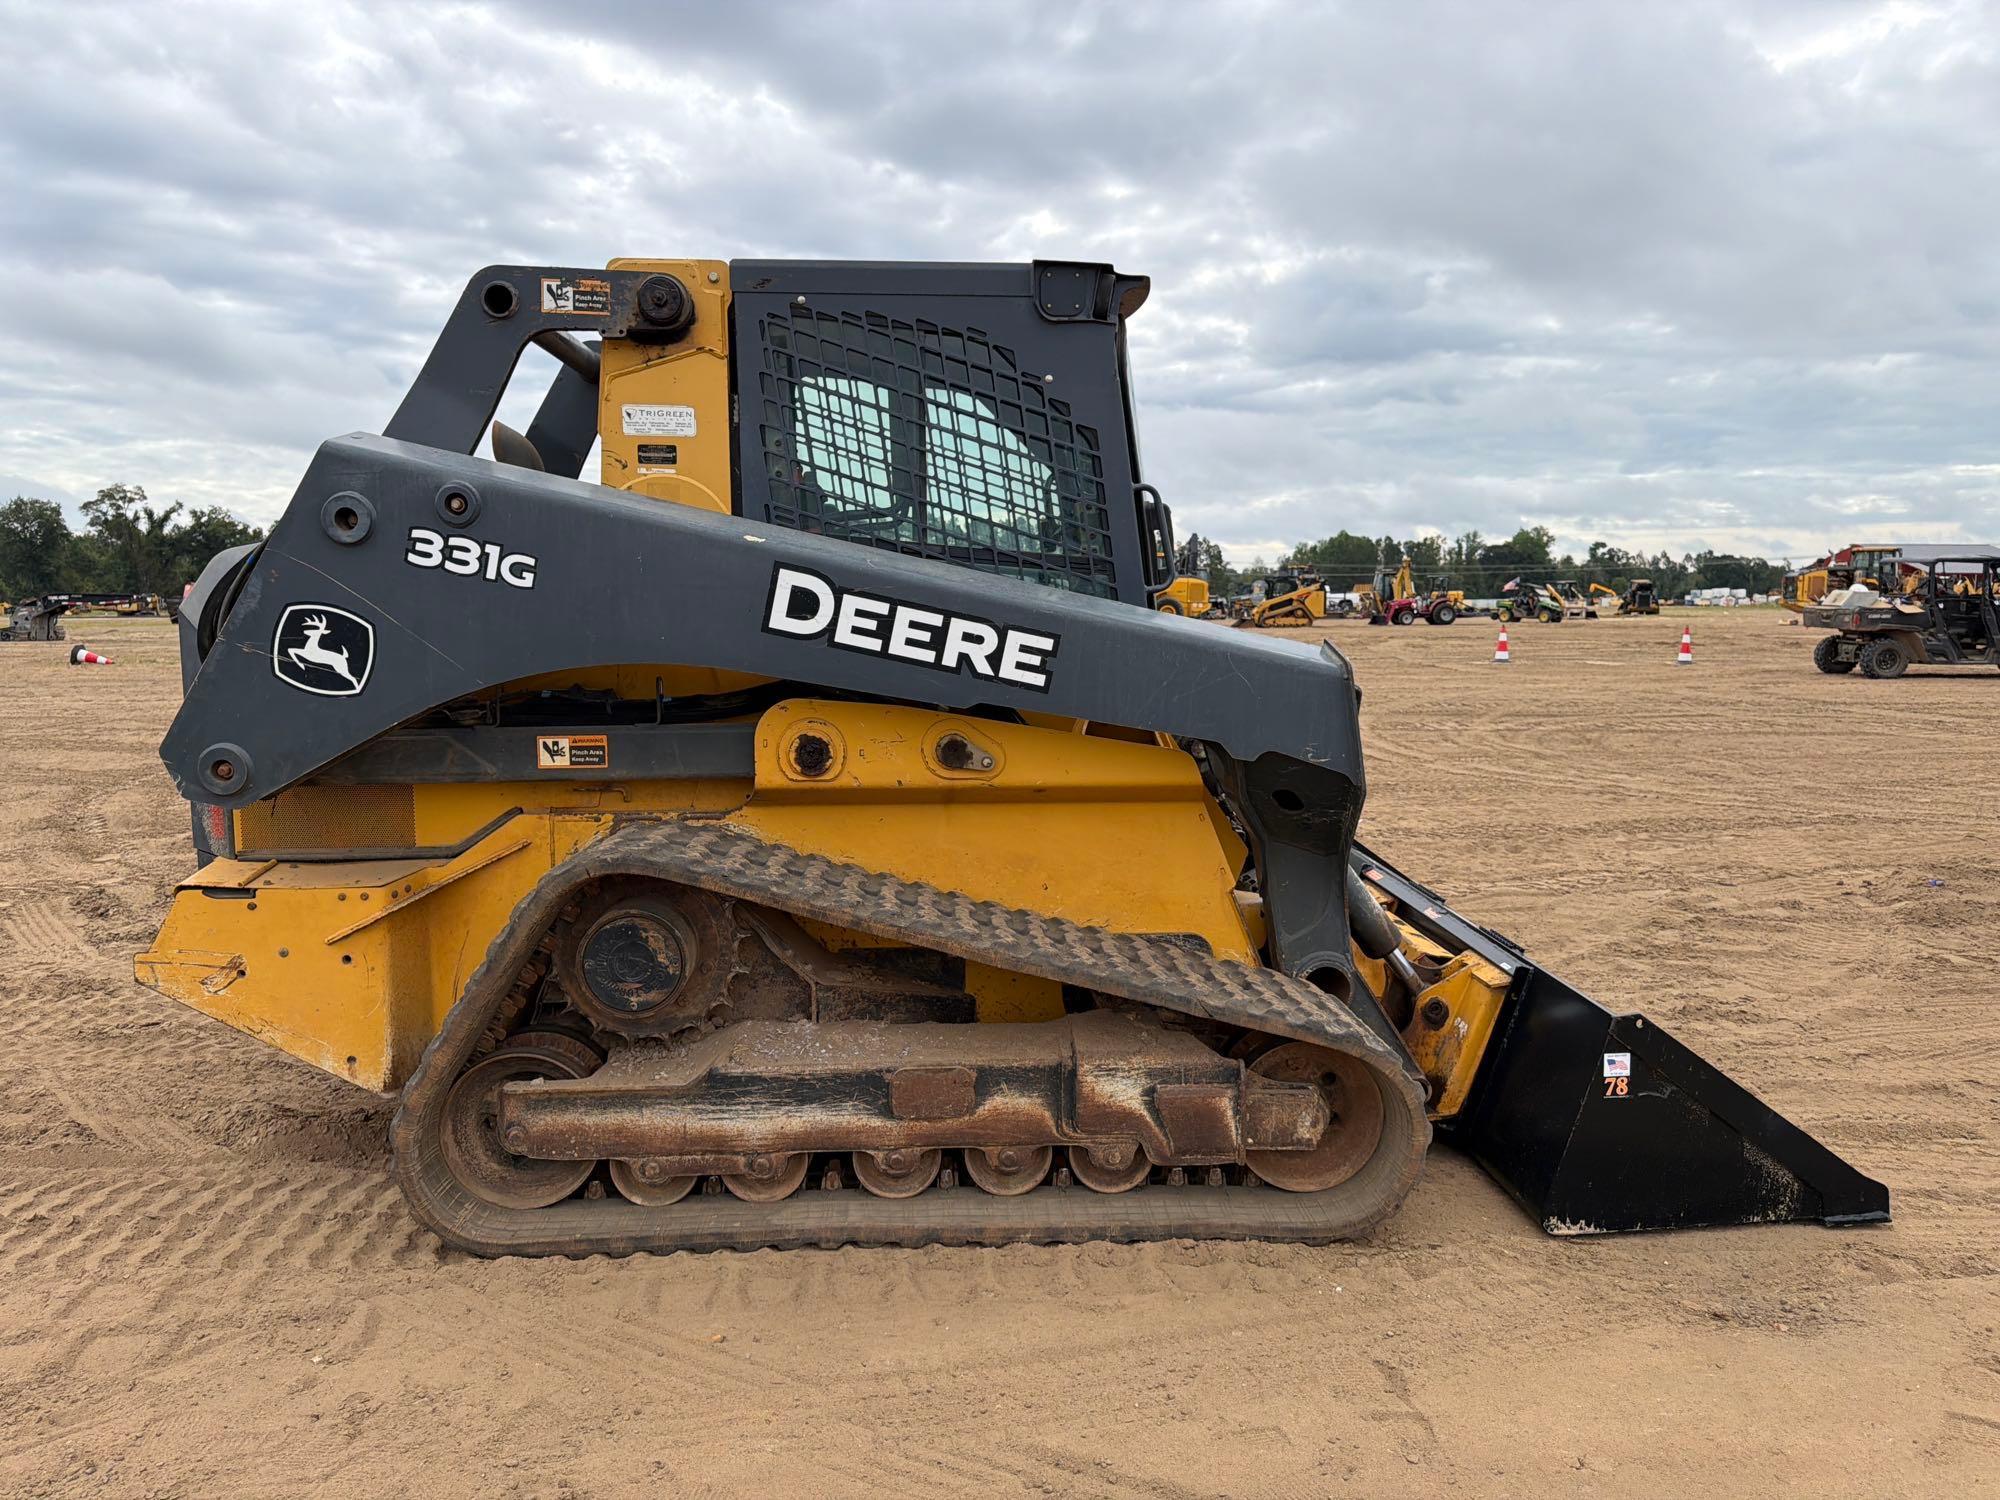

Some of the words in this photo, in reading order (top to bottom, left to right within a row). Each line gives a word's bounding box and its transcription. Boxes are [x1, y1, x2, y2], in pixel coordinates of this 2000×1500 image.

[406, 528, 537, 588] 331G
[768, 568, 1054, 687] DEERE
[1604, 1076, 1629, 1096] 78
